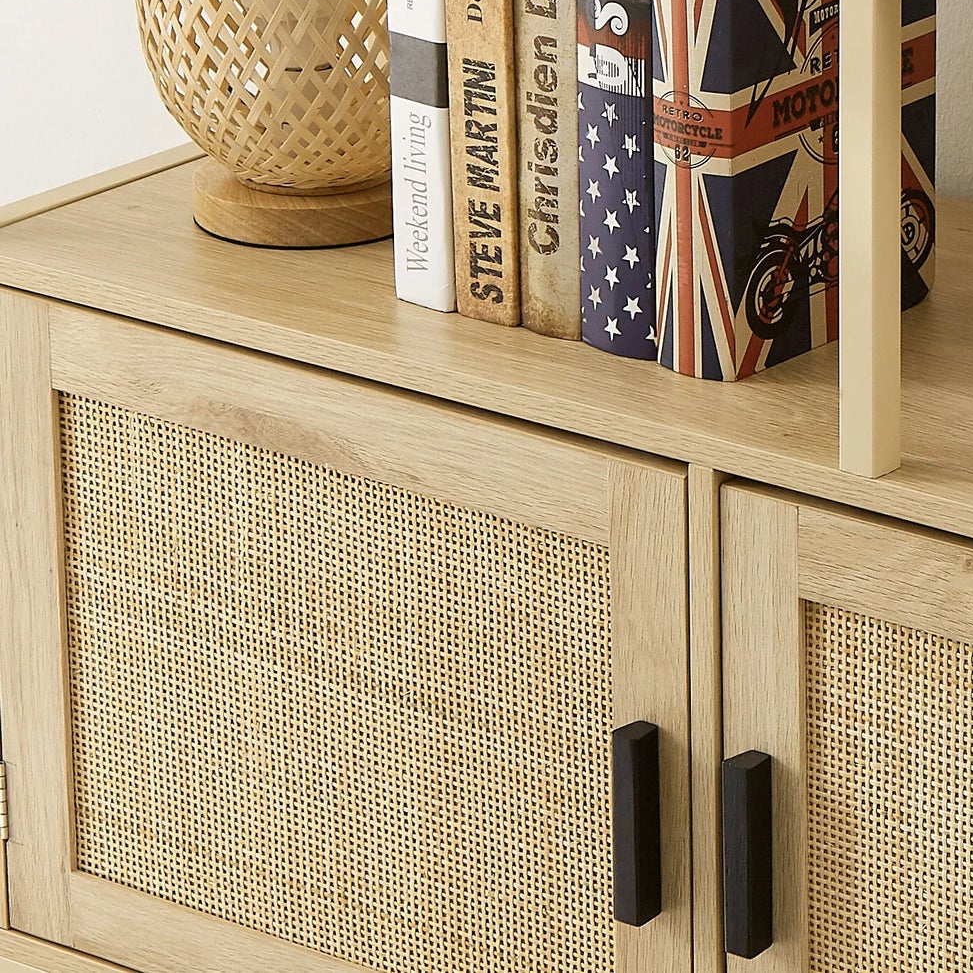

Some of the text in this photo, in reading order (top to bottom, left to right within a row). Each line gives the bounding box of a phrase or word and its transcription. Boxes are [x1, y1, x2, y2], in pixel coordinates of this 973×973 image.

[402, 112, 432, 273] Weekend living
[462, 57, 504, 304] STEVE MARTINI
[526, 35, 560, 256] Chrisdien
[662, 104, 704, 123] RETRO
